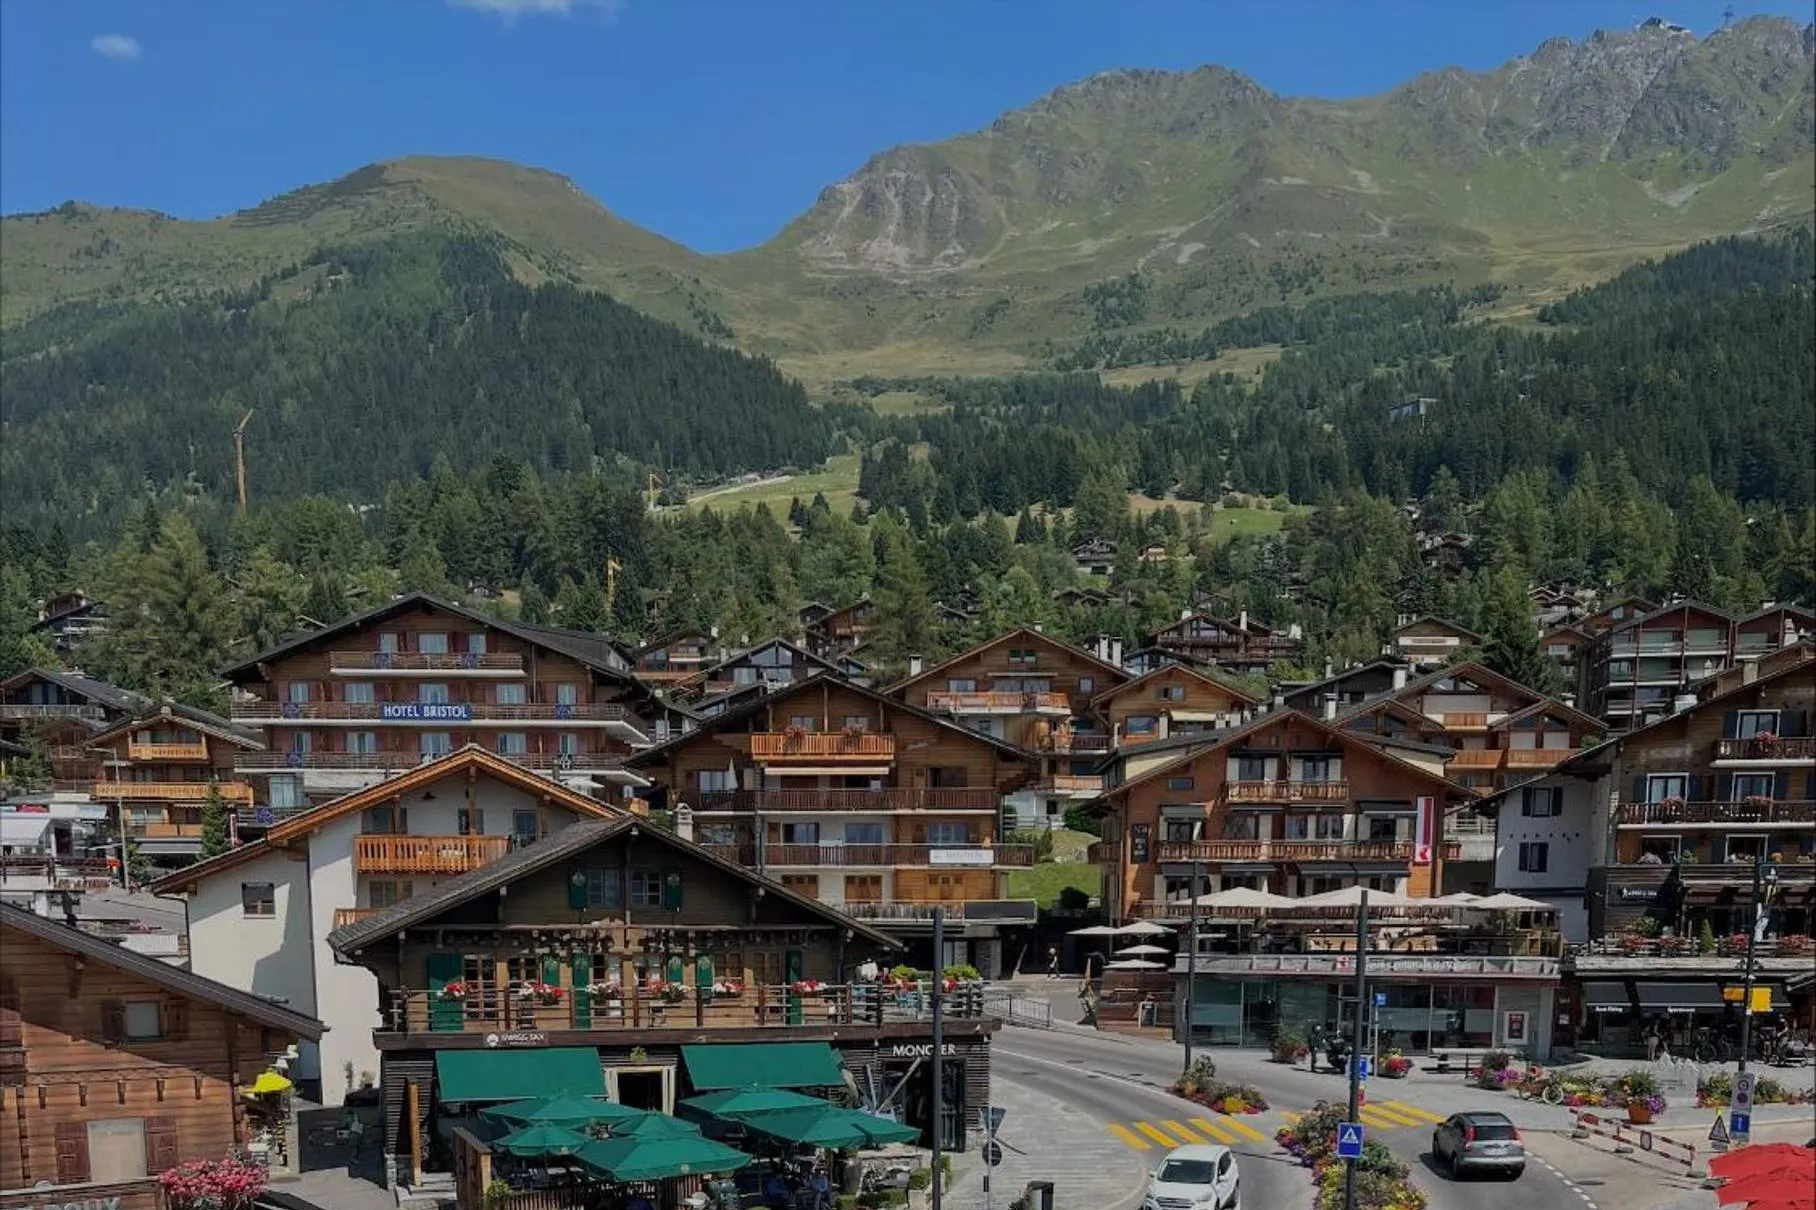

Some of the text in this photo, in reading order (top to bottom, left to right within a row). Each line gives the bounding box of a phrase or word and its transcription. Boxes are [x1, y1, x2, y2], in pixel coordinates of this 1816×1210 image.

[384, 705, 468, 718] HOTEL BRISTOL
[893, 1044, 956, 1057] MONCER
